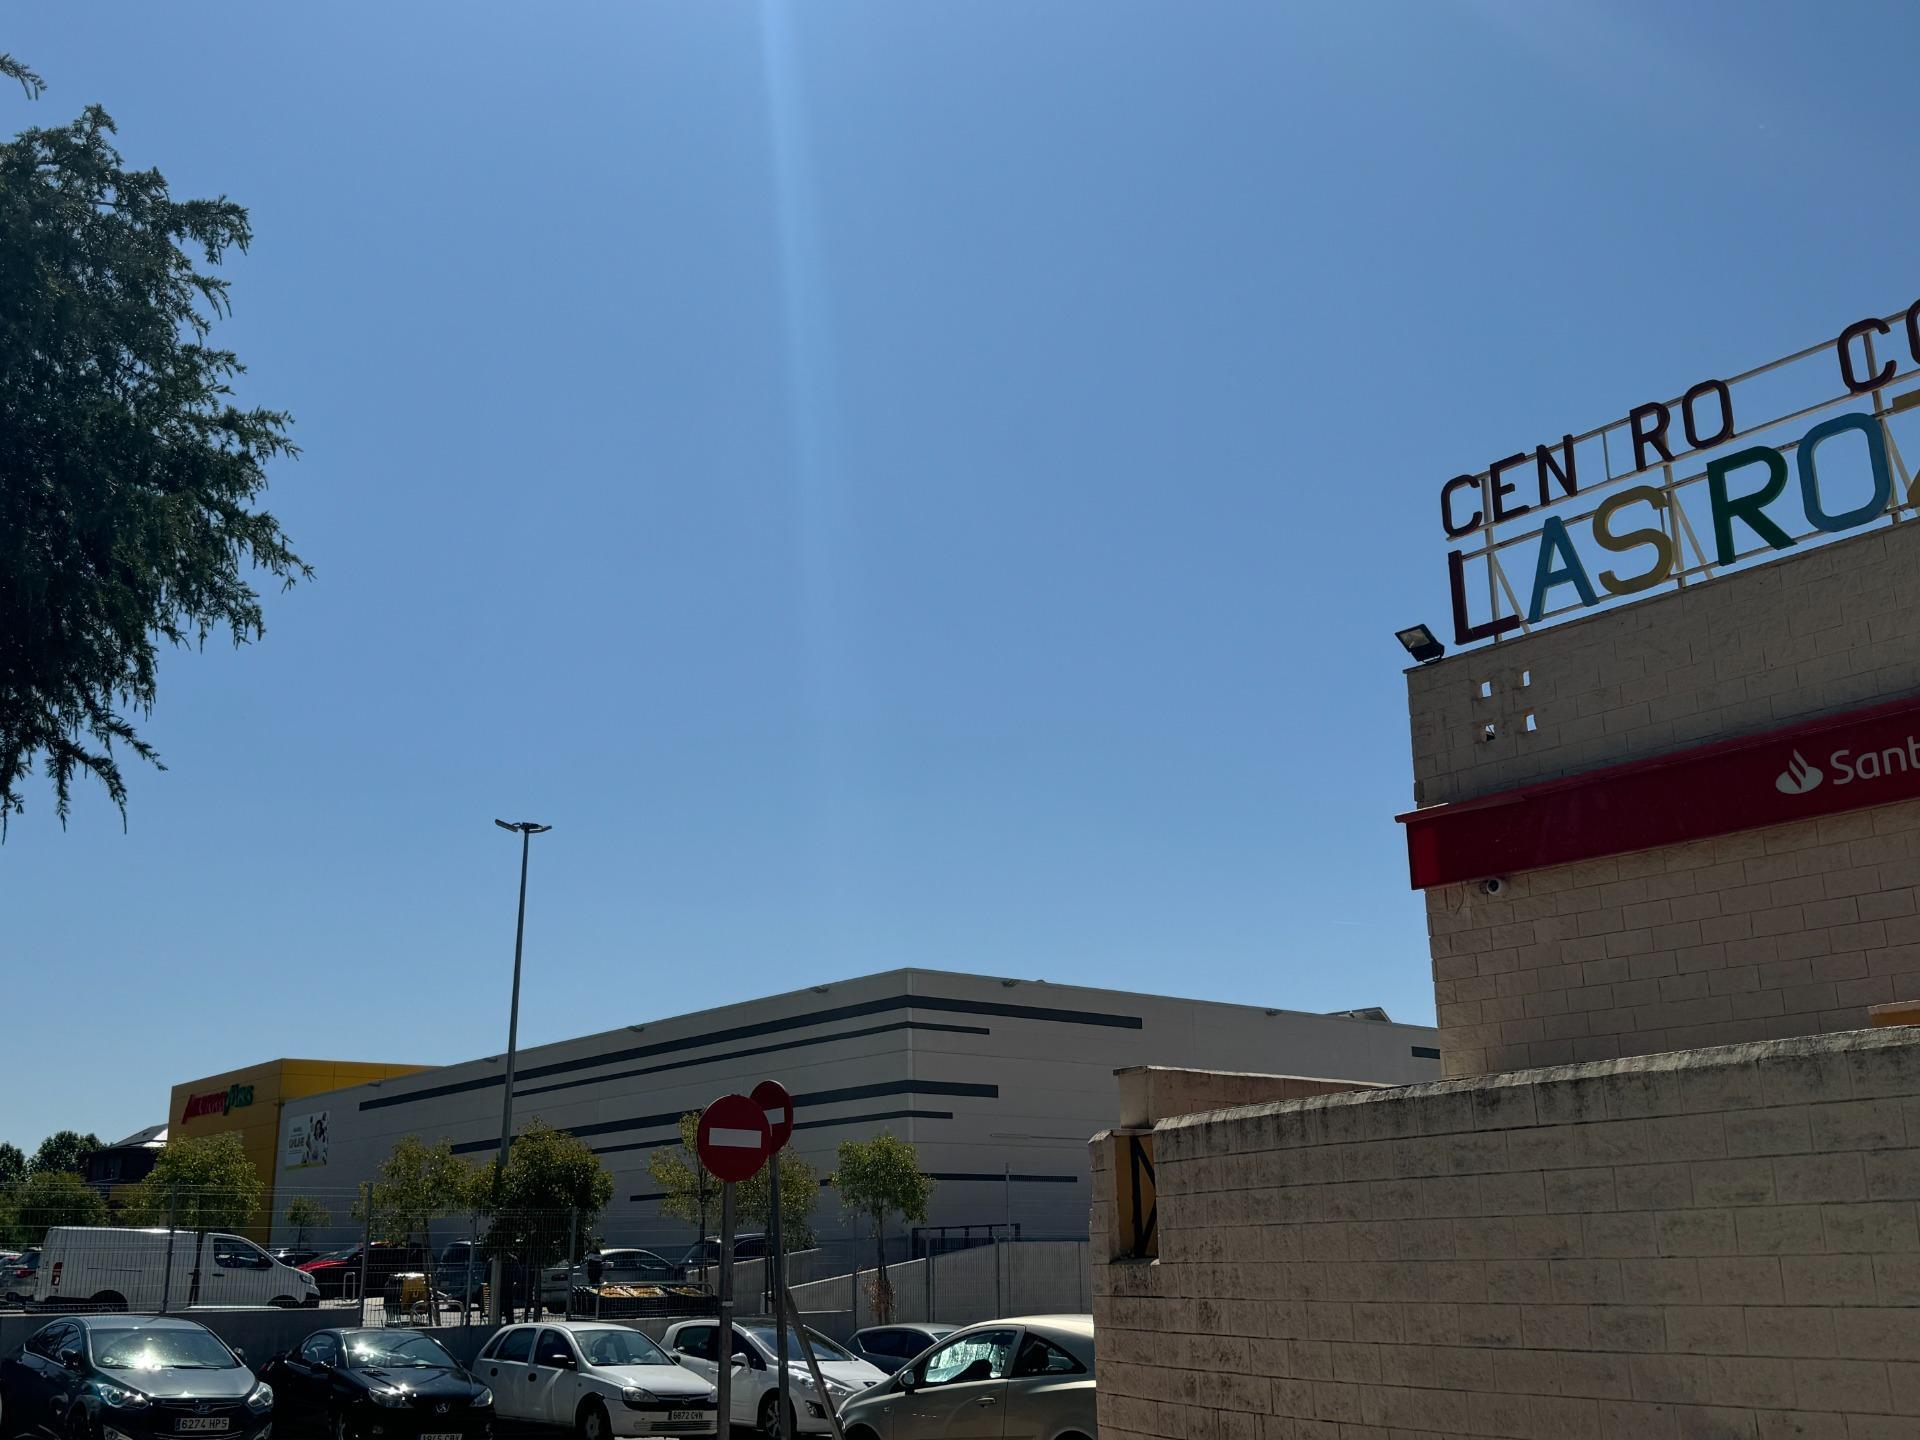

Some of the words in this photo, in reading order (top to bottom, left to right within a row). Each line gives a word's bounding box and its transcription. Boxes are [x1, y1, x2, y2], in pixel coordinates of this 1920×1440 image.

[1837, 298, 1920, 394] C
[1830, 735, 1920, 785] Sant
[181, 1419, 206, 1429] 6274
[209, 1418, 228, 1429] HPS
